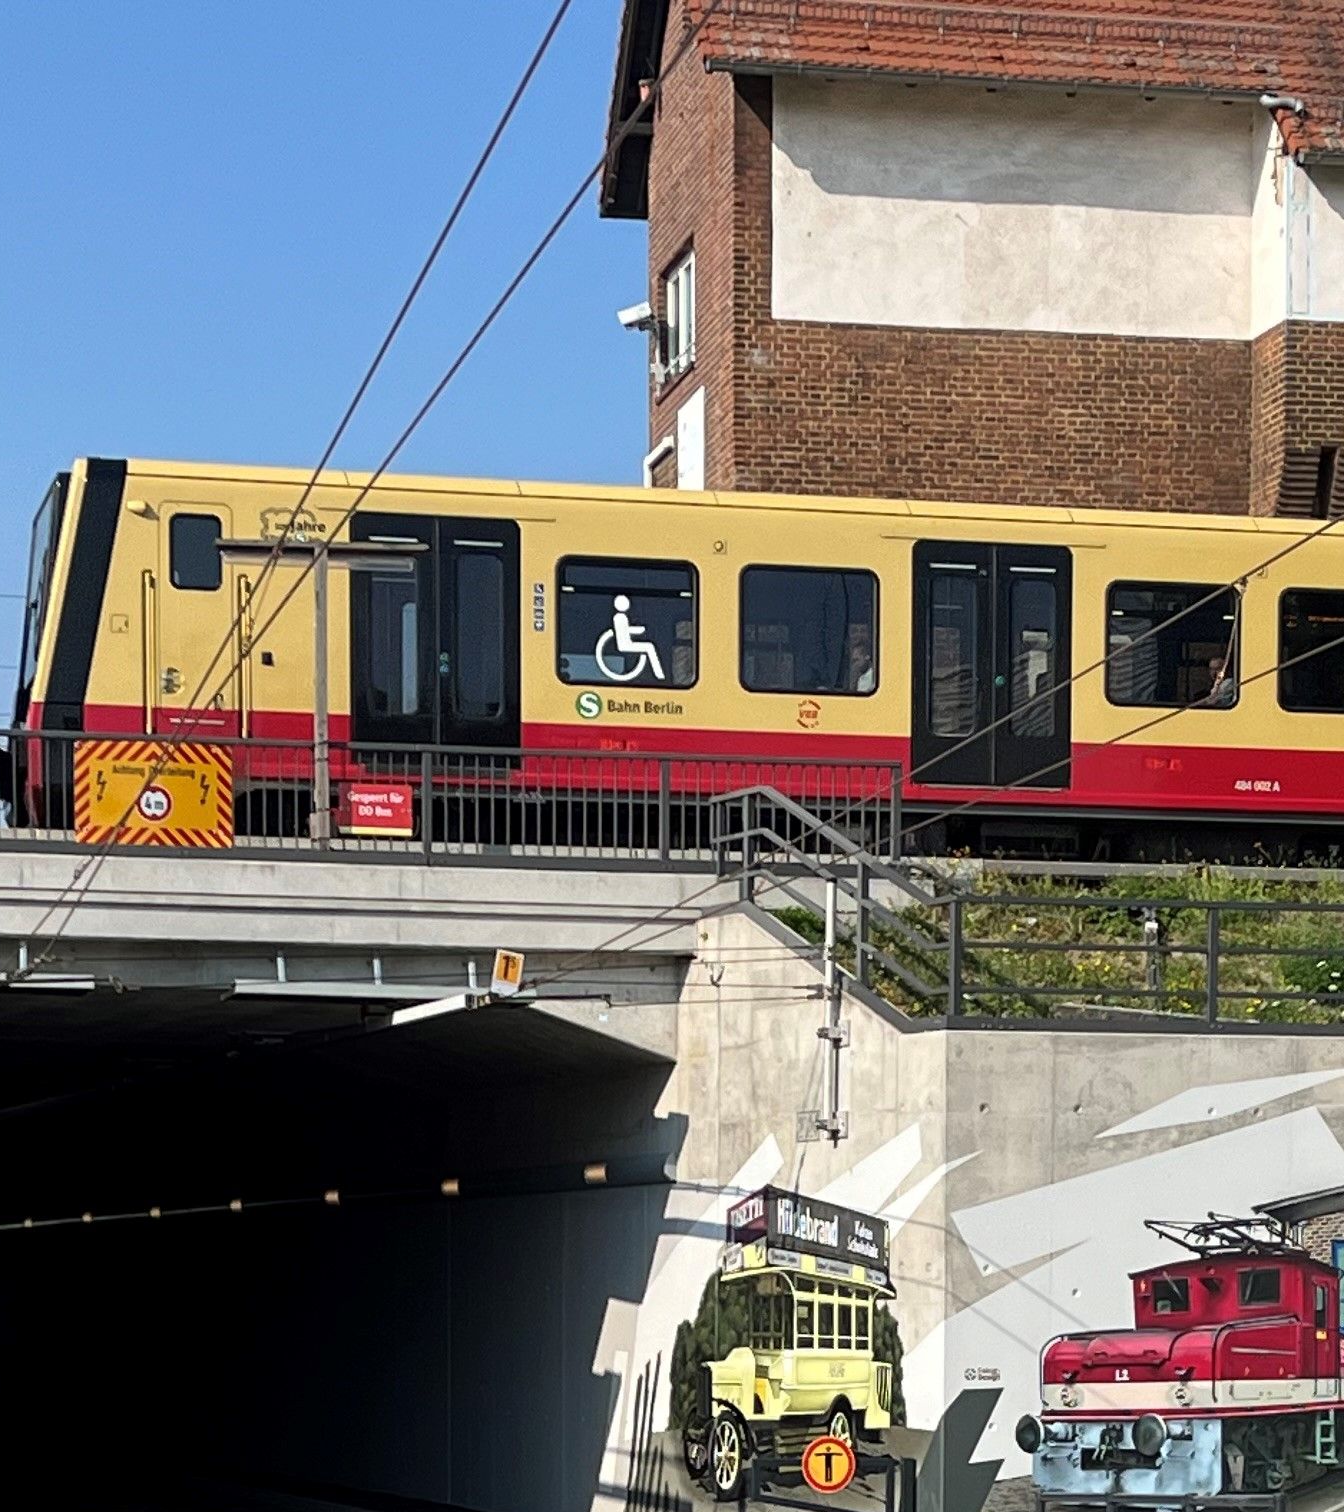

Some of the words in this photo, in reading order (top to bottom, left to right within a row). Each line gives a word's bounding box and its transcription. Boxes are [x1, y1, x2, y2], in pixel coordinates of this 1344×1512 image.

[579, 692, 600, 718] S
[608, 699, 640, 713] Bahn
[644, 702, 683, 715] Berlin
[1272, 781, 1280, 792] A
[144, 796, 152, 810] 4
[777, 1197, 839, 1248] Hildebrand
